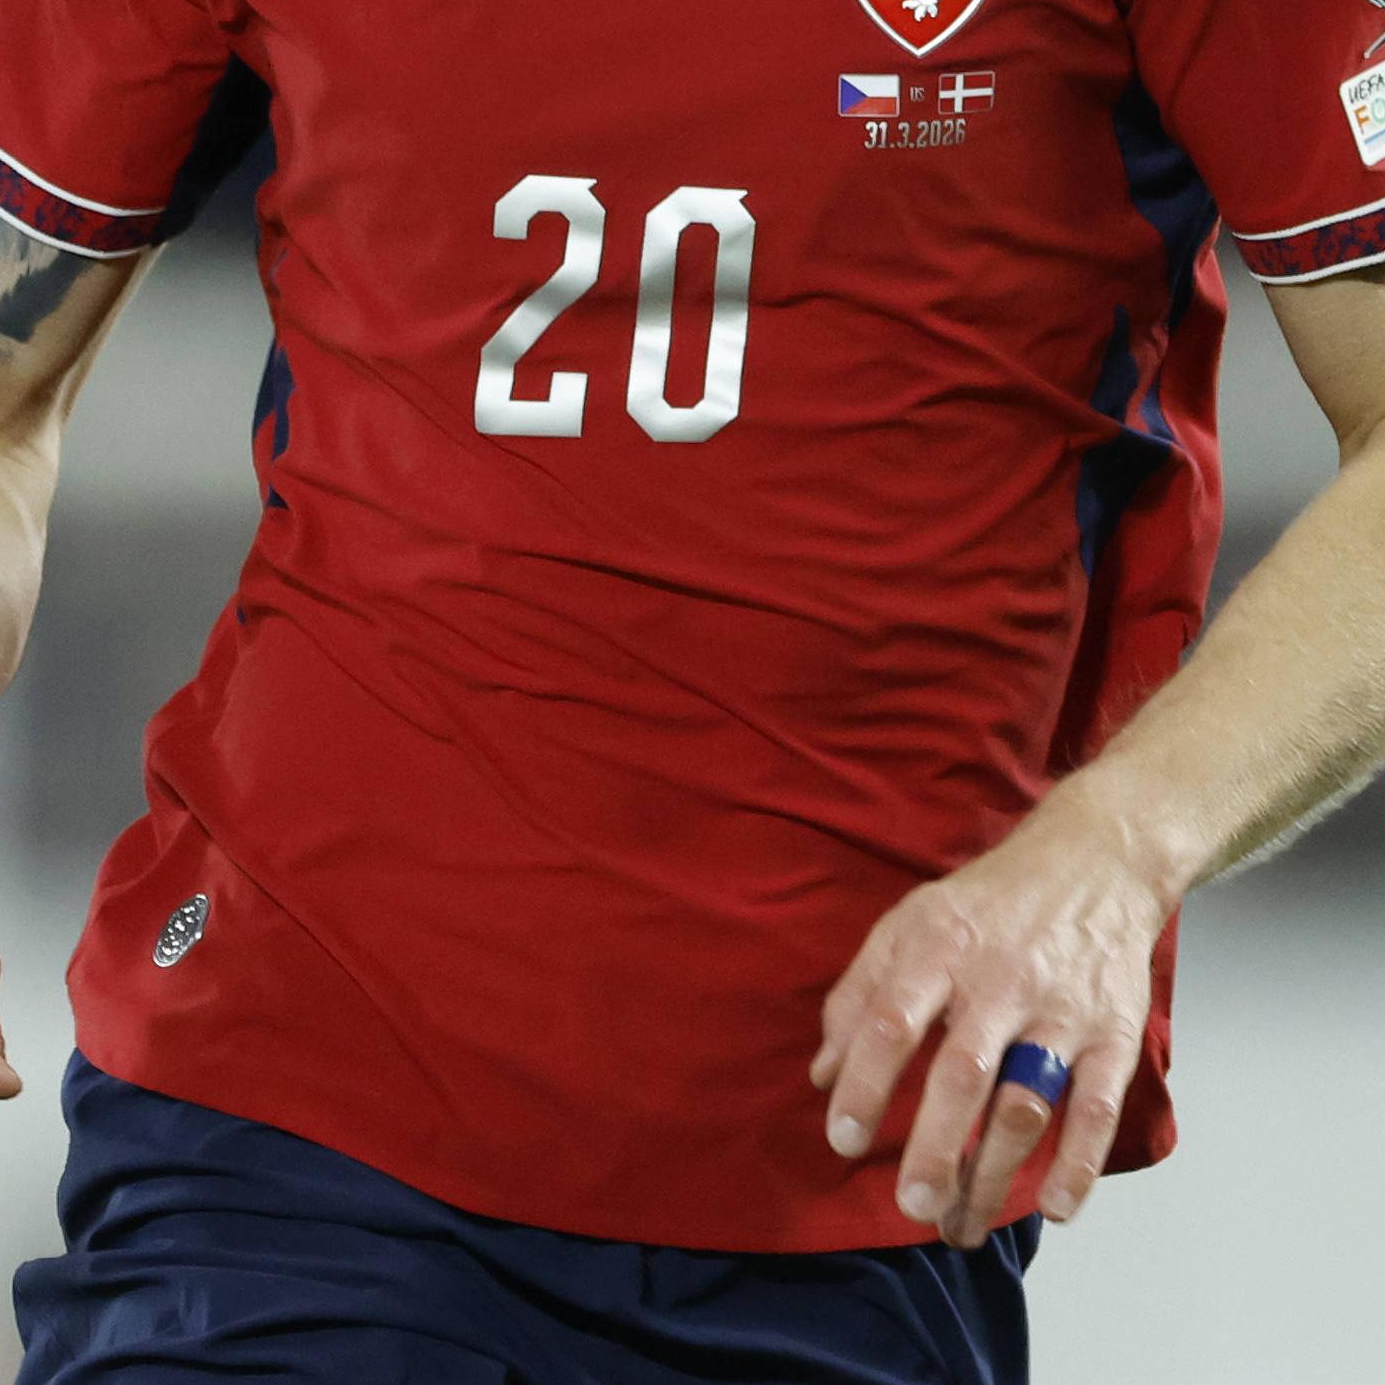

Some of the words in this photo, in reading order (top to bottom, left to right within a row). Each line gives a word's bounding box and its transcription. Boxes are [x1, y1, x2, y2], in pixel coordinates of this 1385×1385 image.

[1348, 73, 1385, 104] UEFA
[864, 118, 967, 150] 31.3.2026
[474, 174, 756, 443] 20
